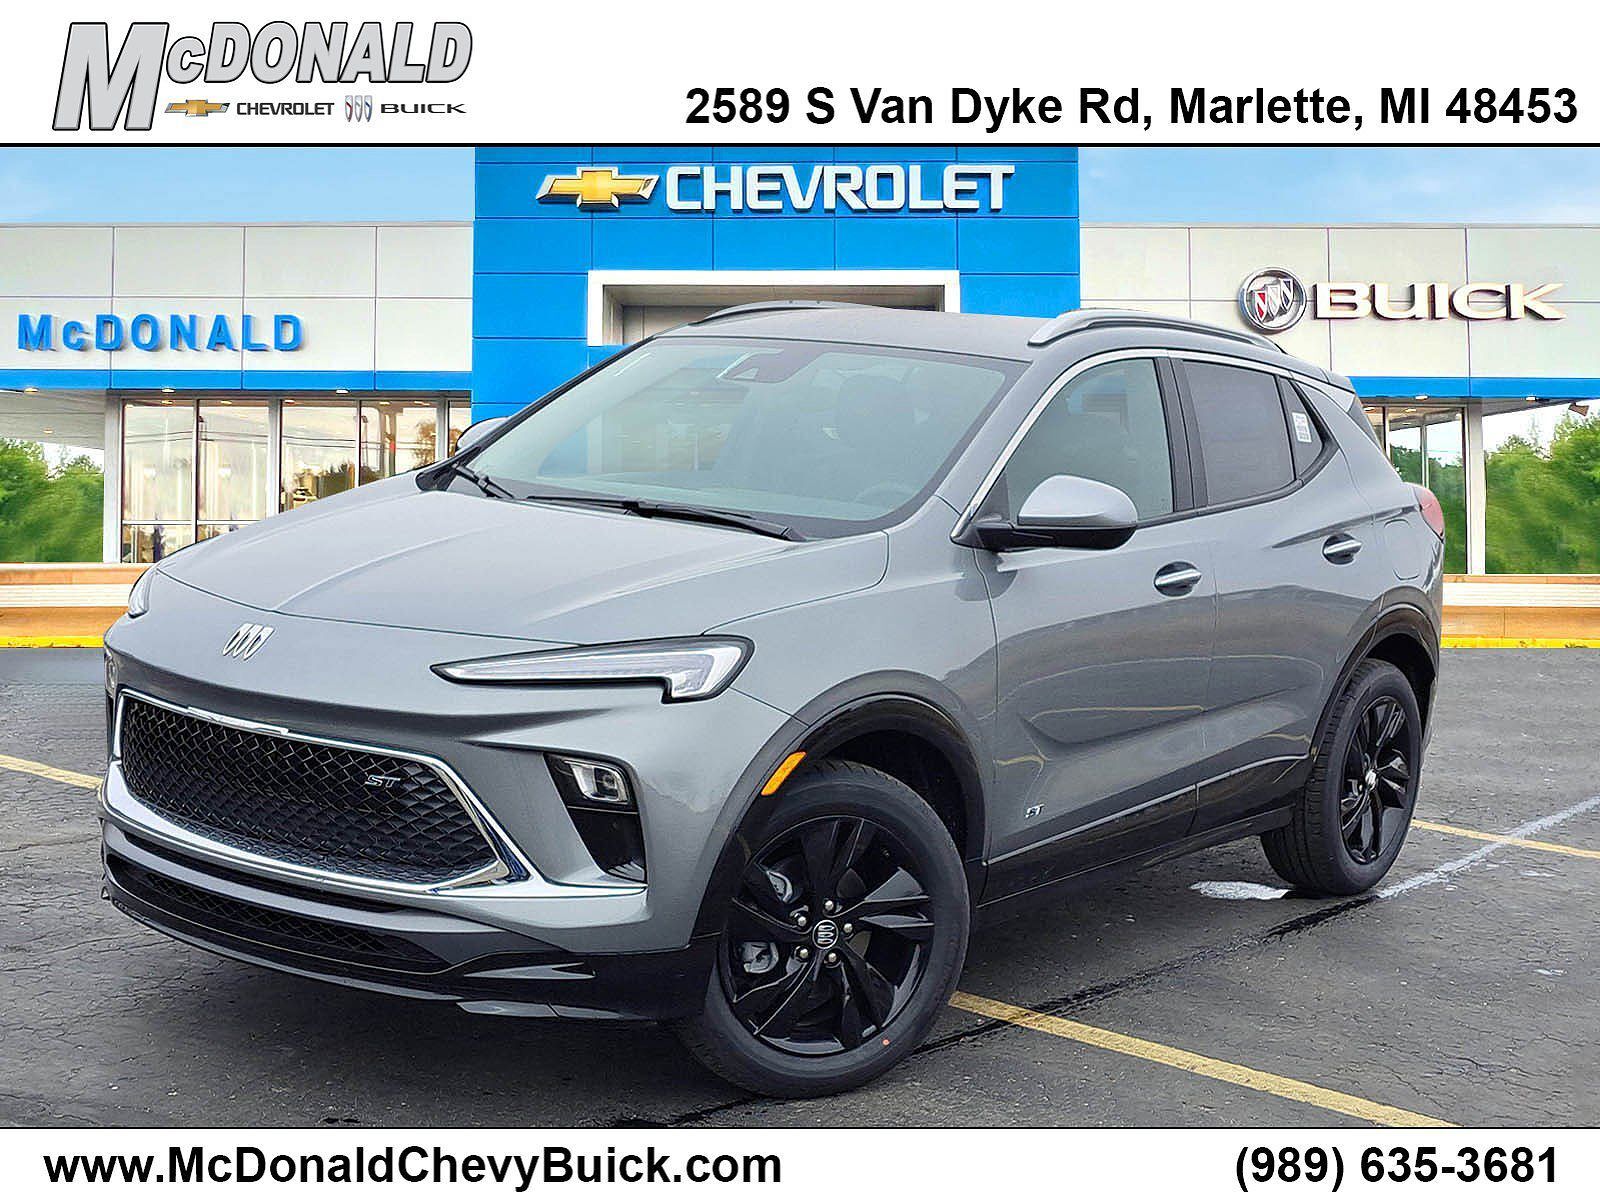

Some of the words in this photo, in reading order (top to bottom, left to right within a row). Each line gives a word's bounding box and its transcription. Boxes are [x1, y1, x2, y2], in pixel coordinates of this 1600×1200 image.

[665, 164, 1015, 211] CHEVROLET
[1312, 281, 1567, 321] BUICK
[17, 313, 304, 352] McDONALD
[364, 774, 400, 788] ST
